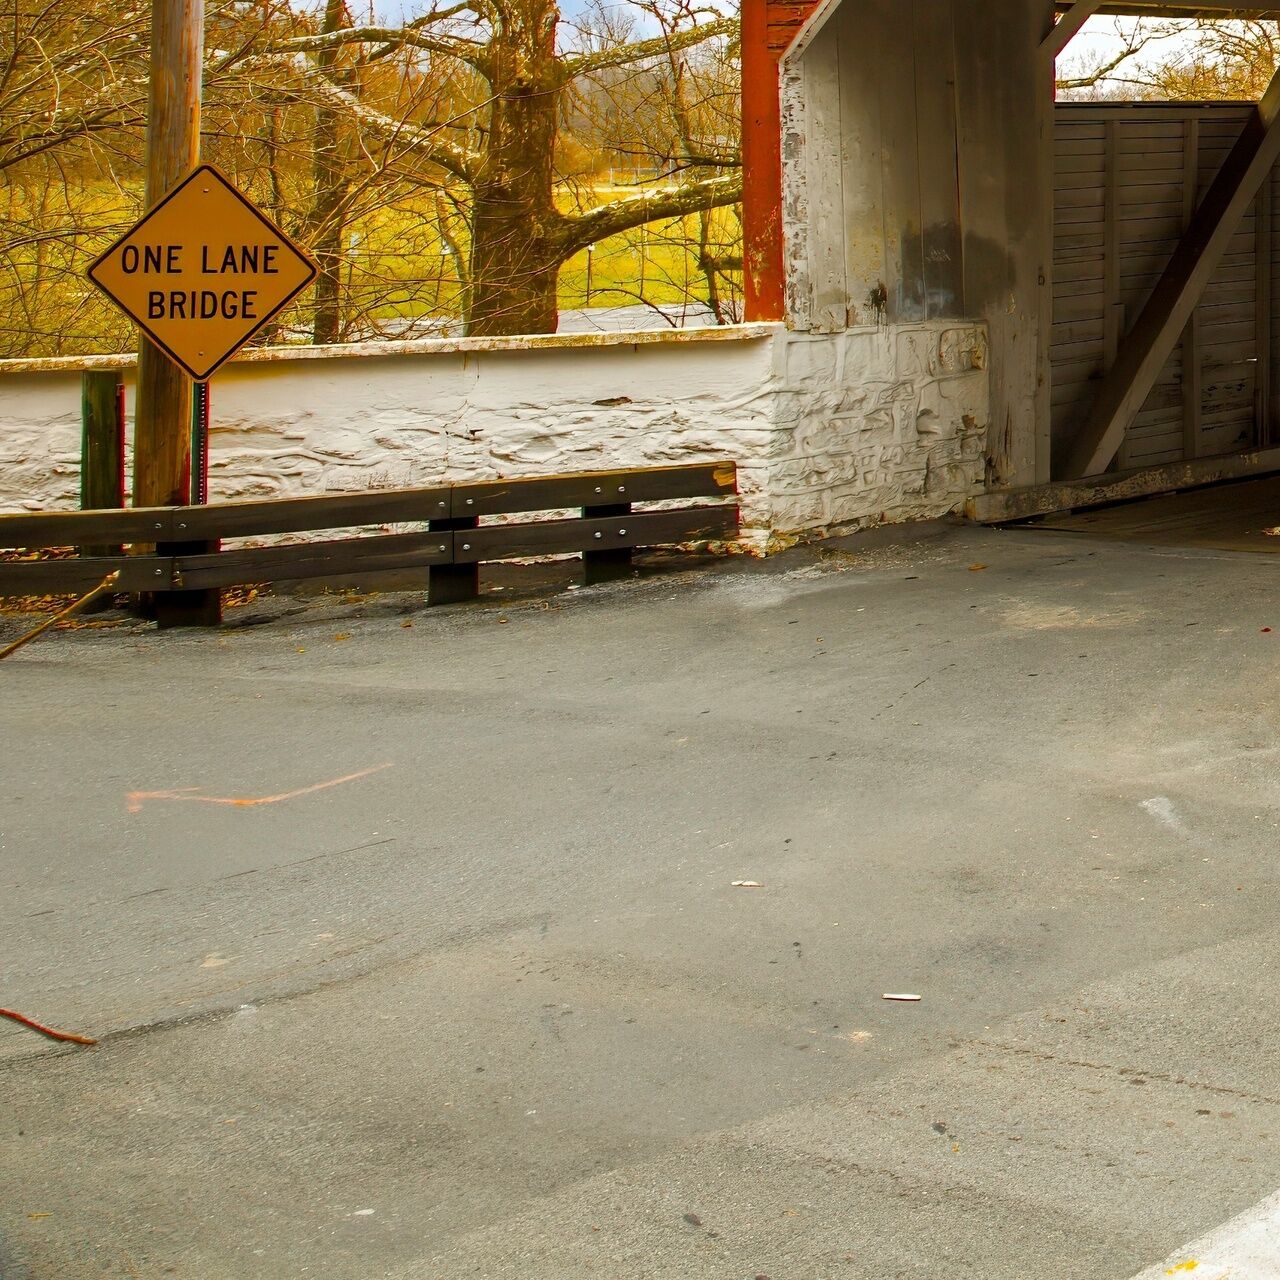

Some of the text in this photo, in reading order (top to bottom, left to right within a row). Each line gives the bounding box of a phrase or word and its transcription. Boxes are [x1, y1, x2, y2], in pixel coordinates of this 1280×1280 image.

[121, 245, 279, 274] ONE LANE
[147, 290, 258, 319] BRIDGE
